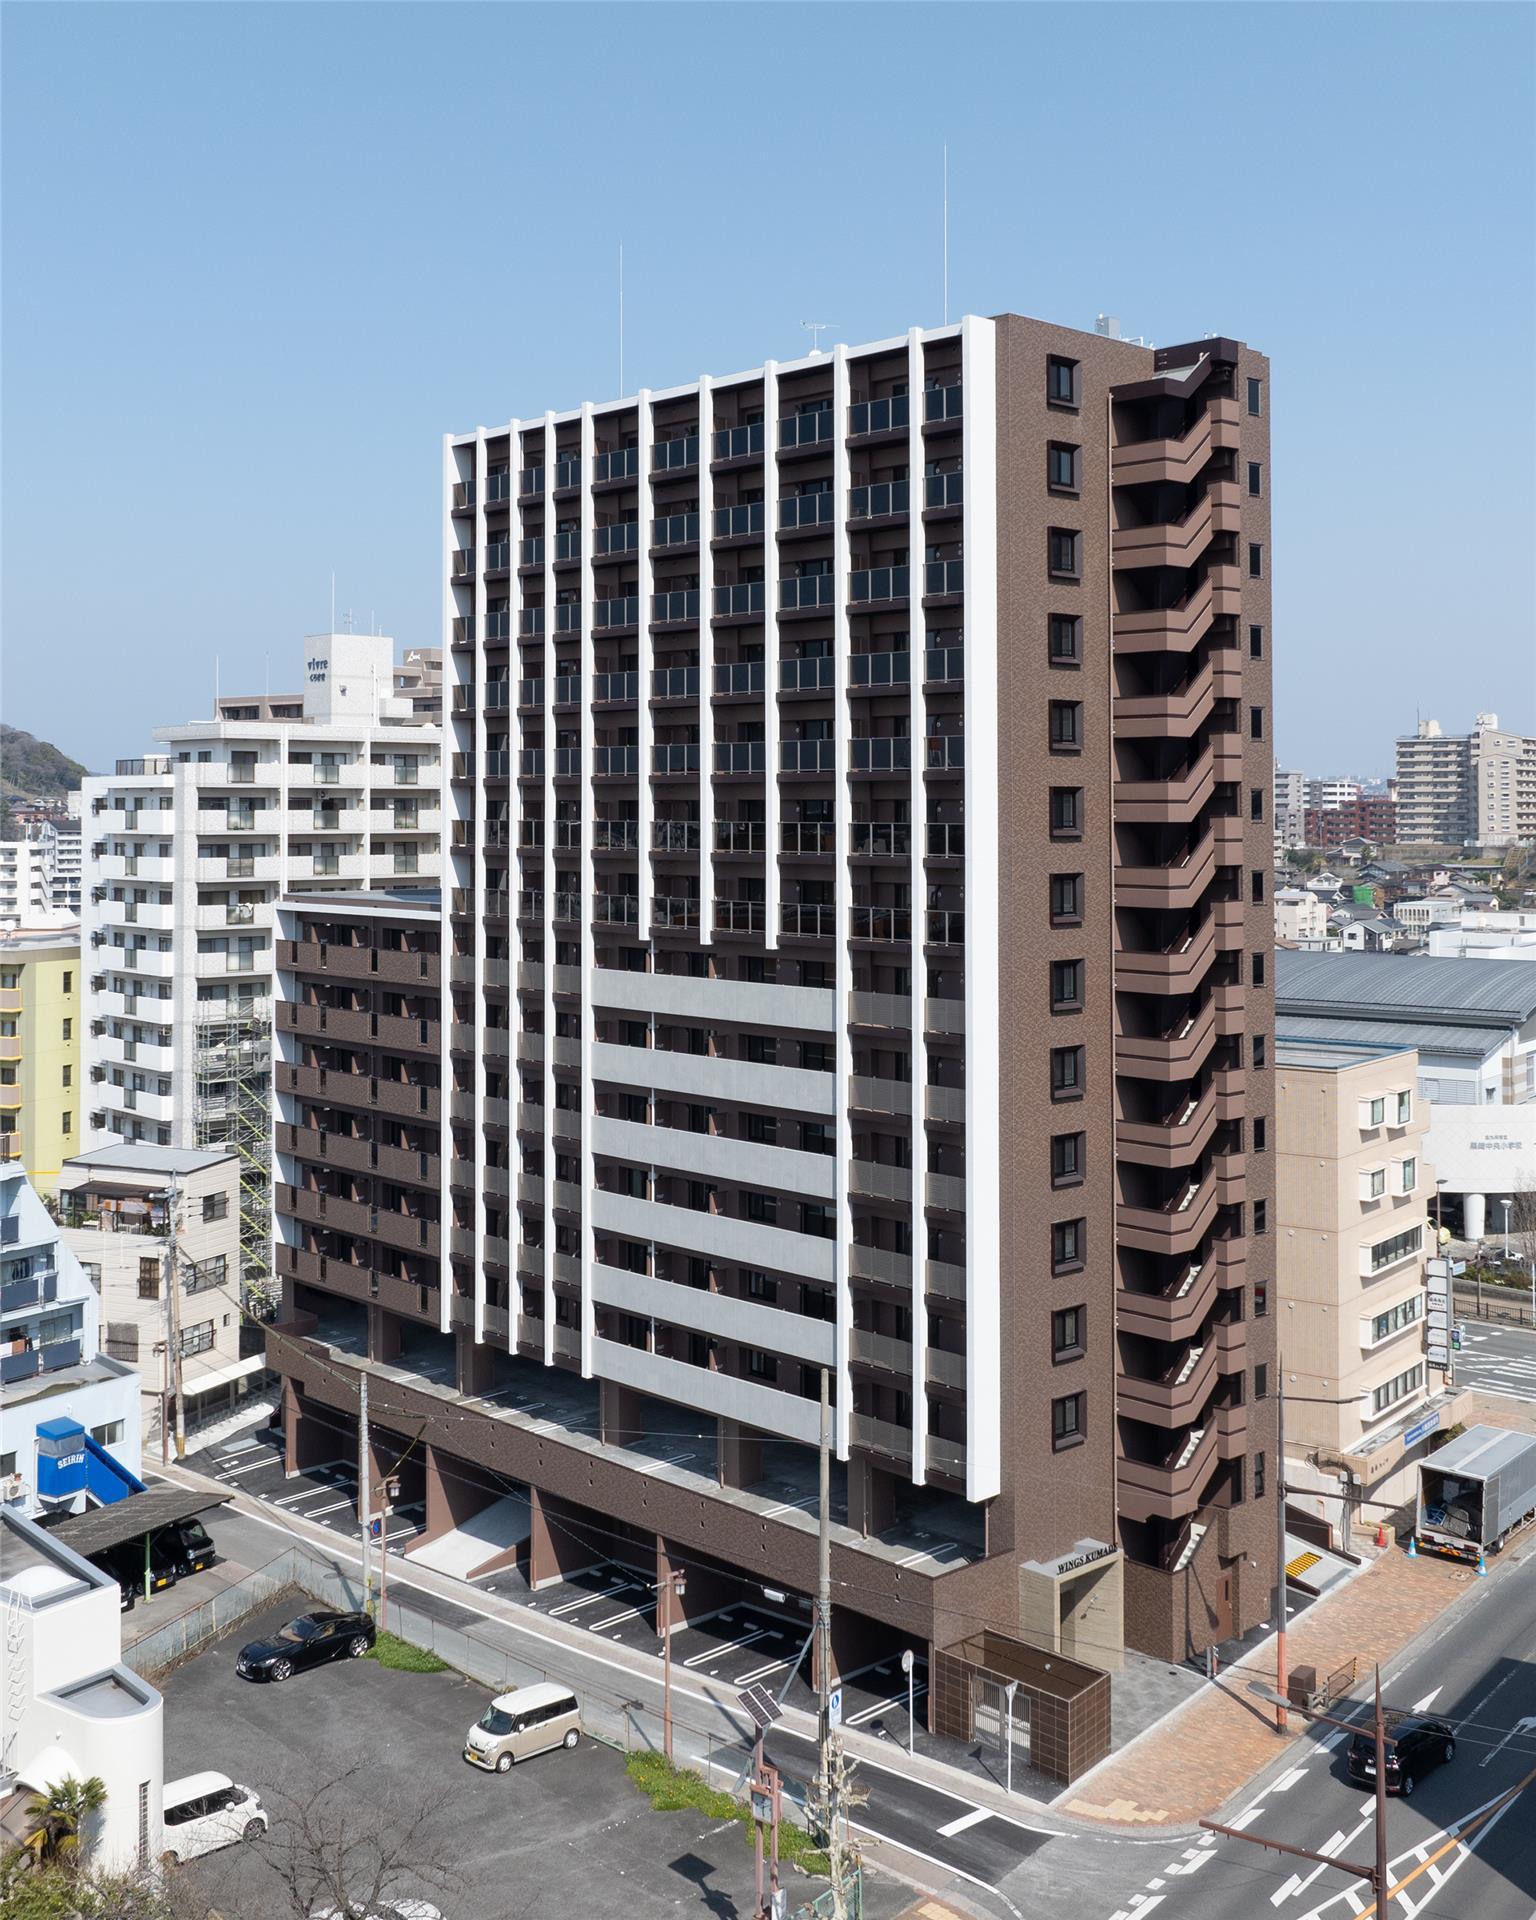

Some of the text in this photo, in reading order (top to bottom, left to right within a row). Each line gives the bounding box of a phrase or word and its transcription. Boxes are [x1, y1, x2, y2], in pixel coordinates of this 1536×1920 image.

[307, 657, 328, 671] vivre
[57, 1453, 85, 1469] SEIRIN
[1057, 1555, 1084, 1575] WINGS
